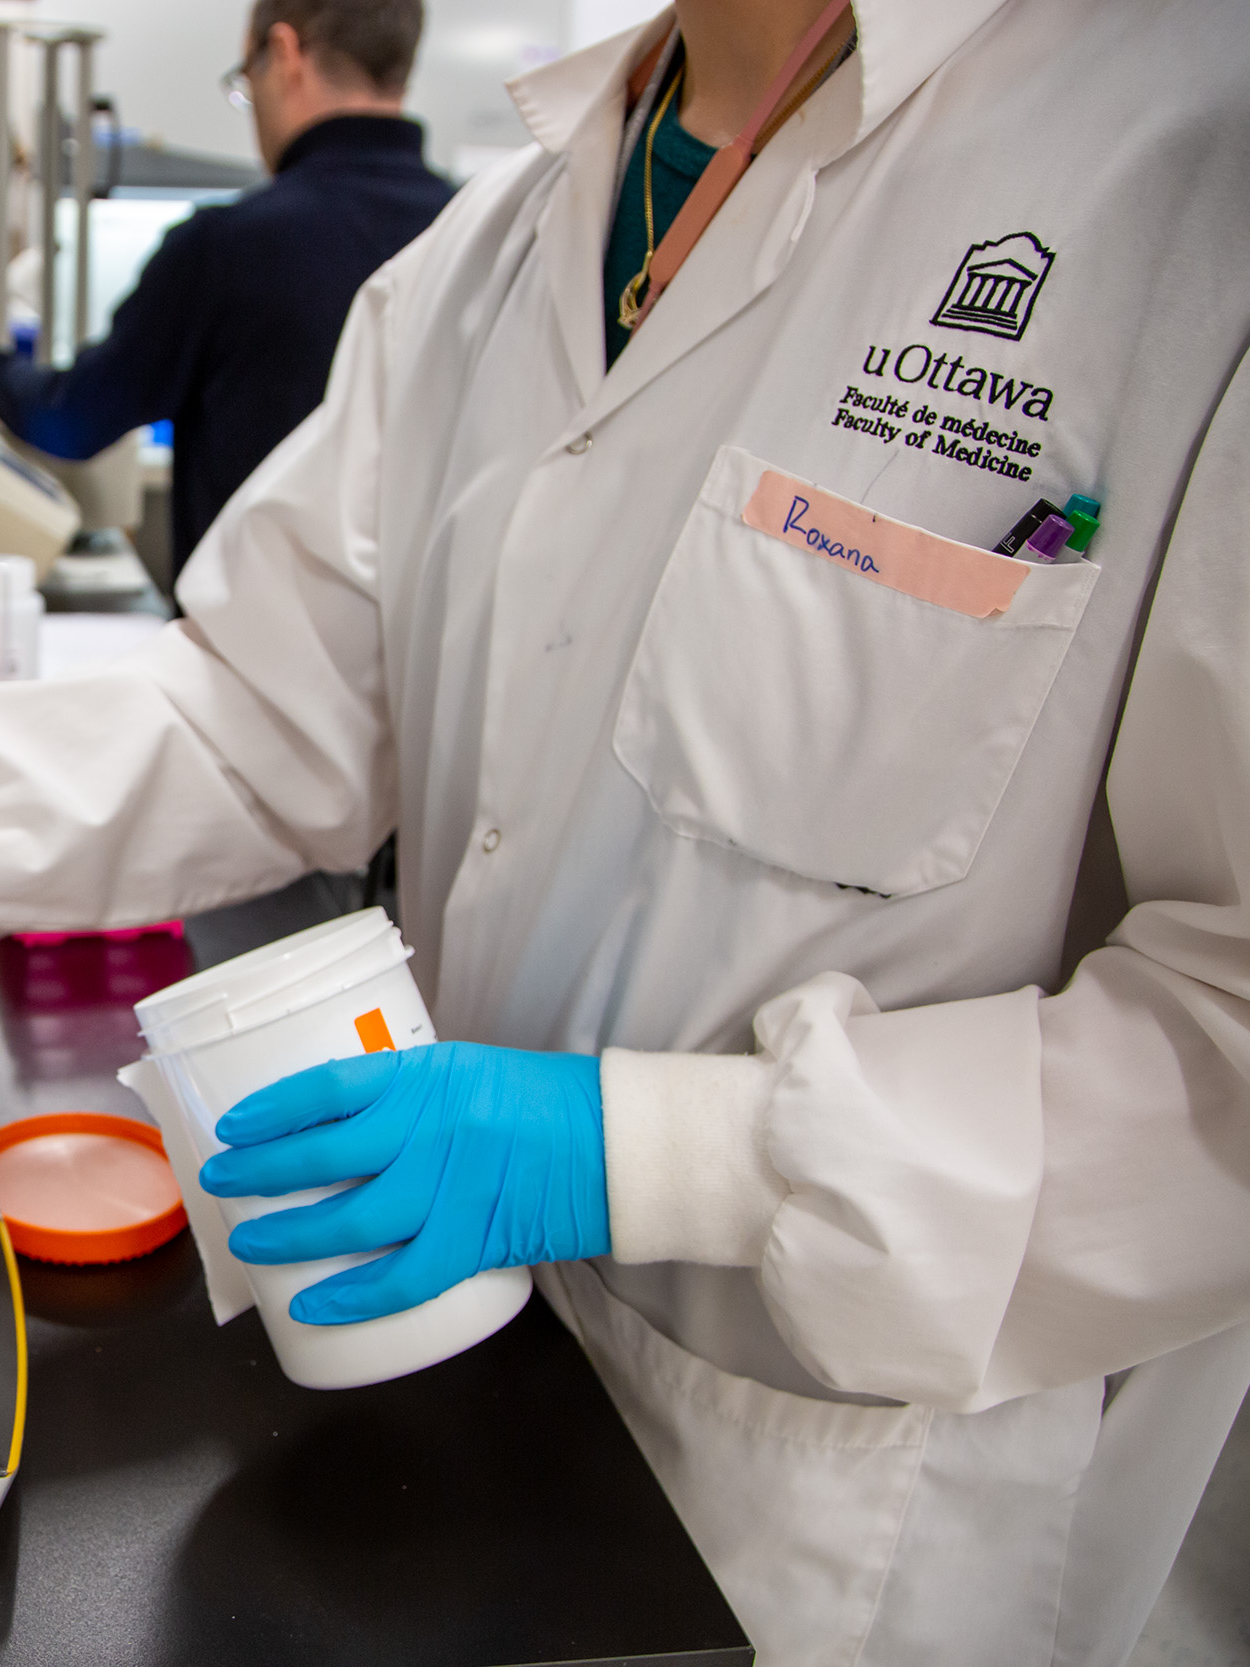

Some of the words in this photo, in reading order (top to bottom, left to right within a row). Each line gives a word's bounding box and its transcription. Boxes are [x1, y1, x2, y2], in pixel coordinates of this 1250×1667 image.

[862, 344, 1054, 422] uOttawa
[831, 408, 902, 444] Faculty
[905, 430, 932, 449] of
[931, 434, 1033, 482] Medicine
[839, 385, 910, 419] Faculté
[912, 405, 938, 426] de
[939, 415, 1042, 458] médecine
[783, 495, 880, 573] Roxana
